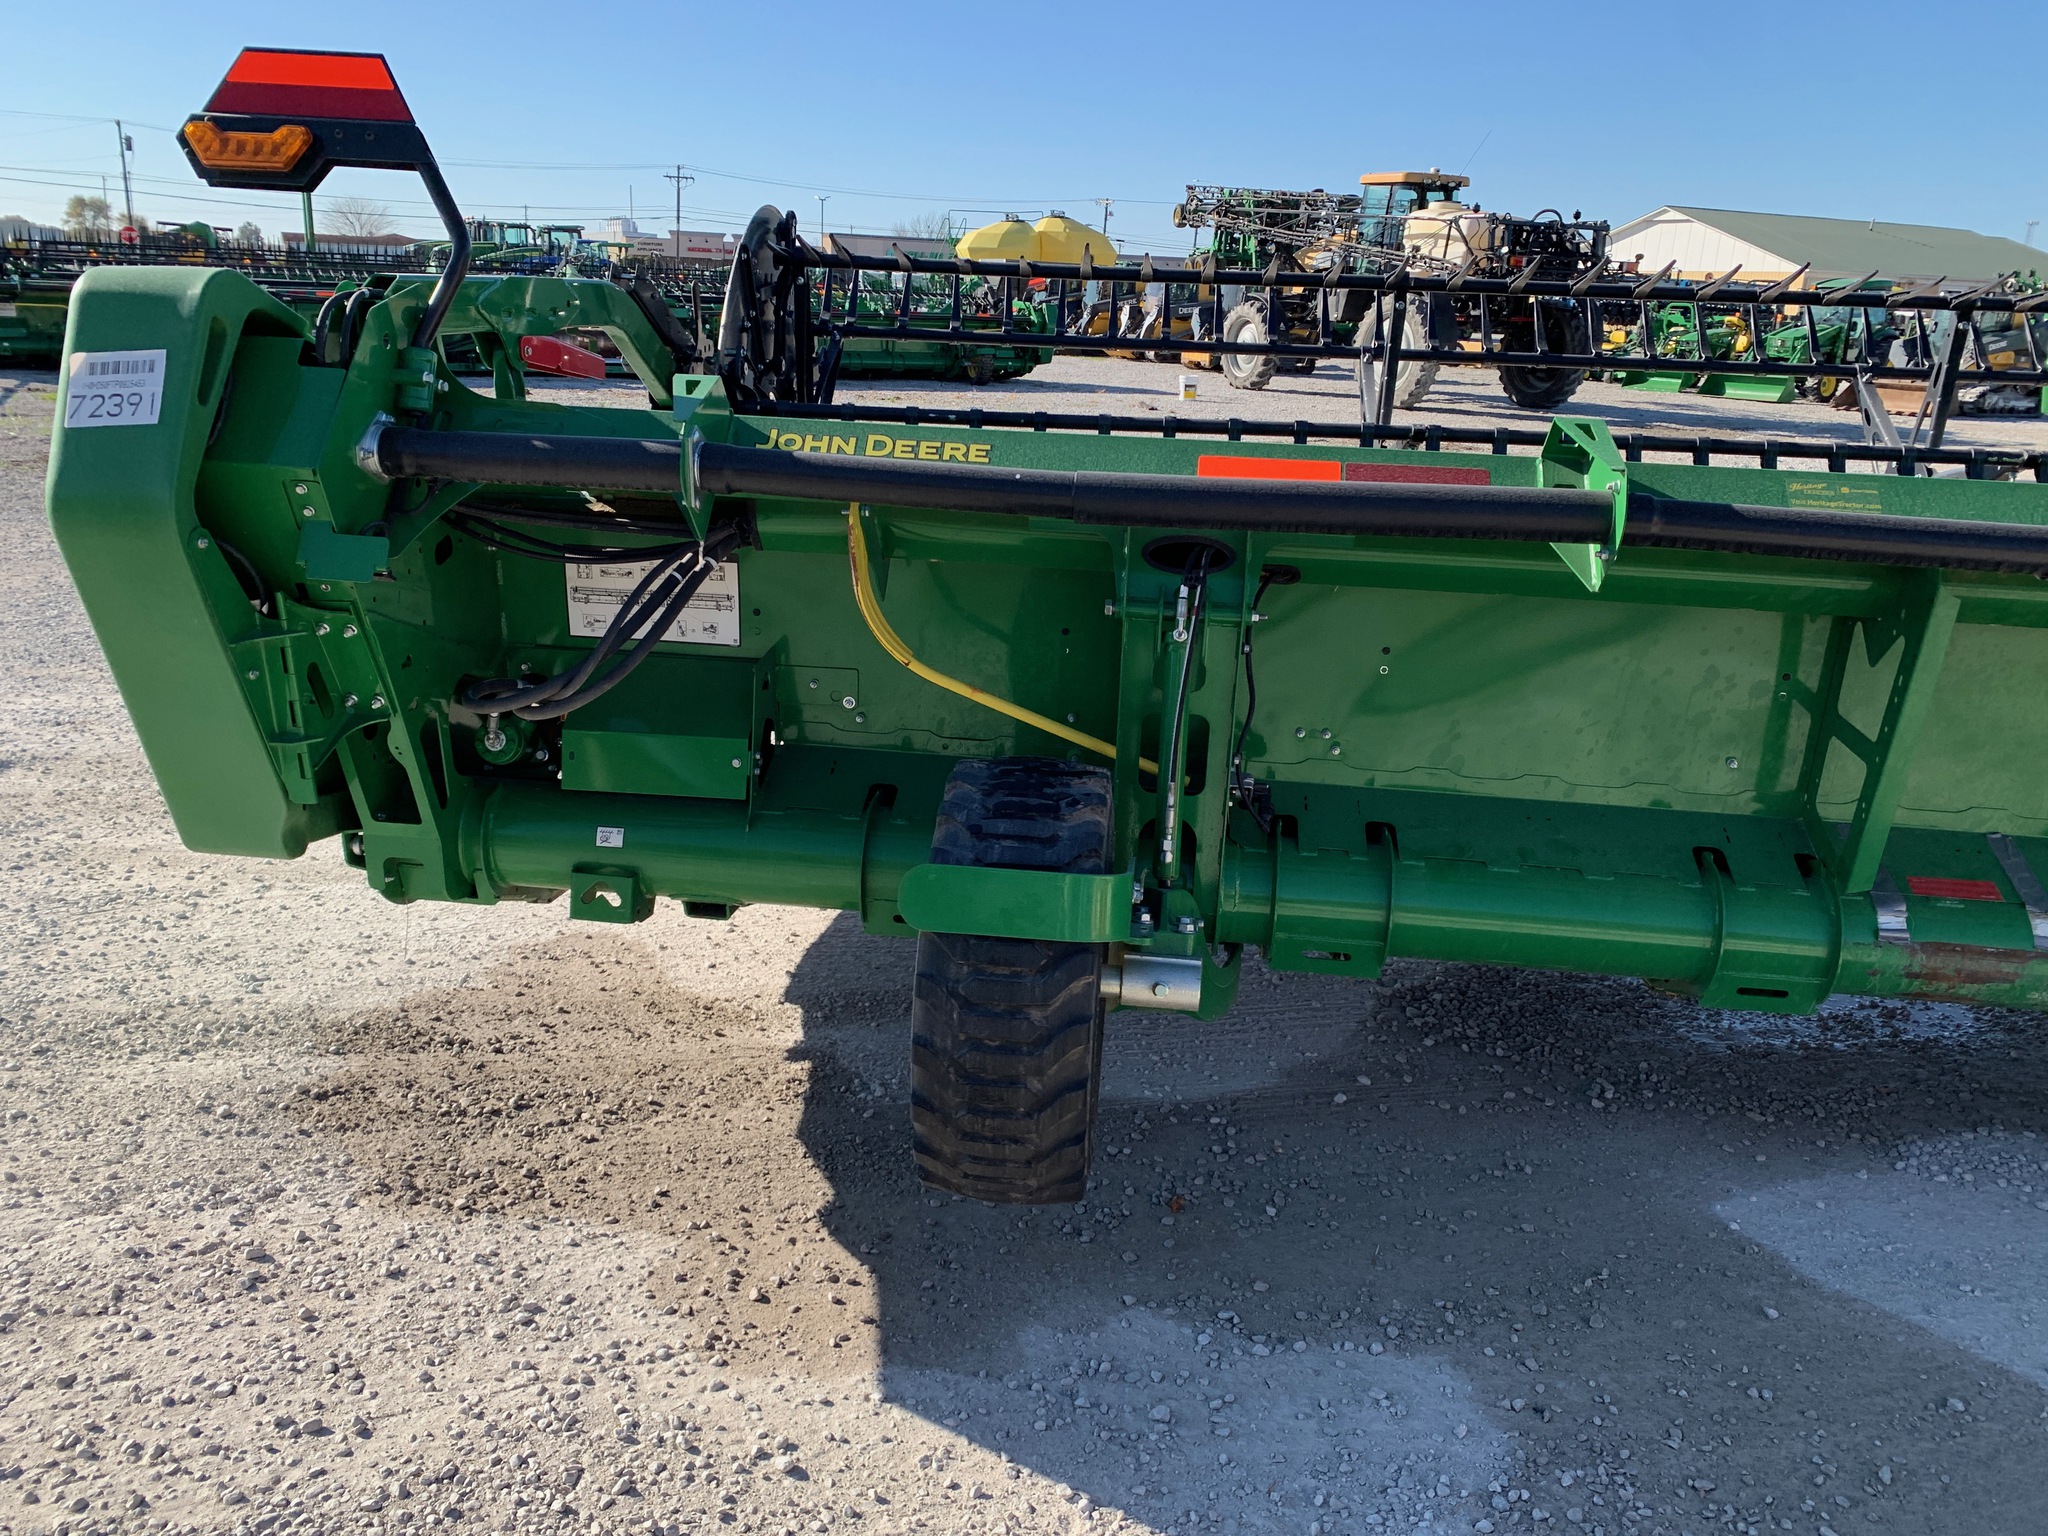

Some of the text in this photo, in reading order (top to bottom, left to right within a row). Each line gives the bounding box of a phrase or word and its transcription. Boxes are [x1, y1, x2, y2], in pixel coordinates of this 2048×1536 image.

[69, 392, 155, 420] 72391
[755, 428, 992, 464] JOHN DEERE
